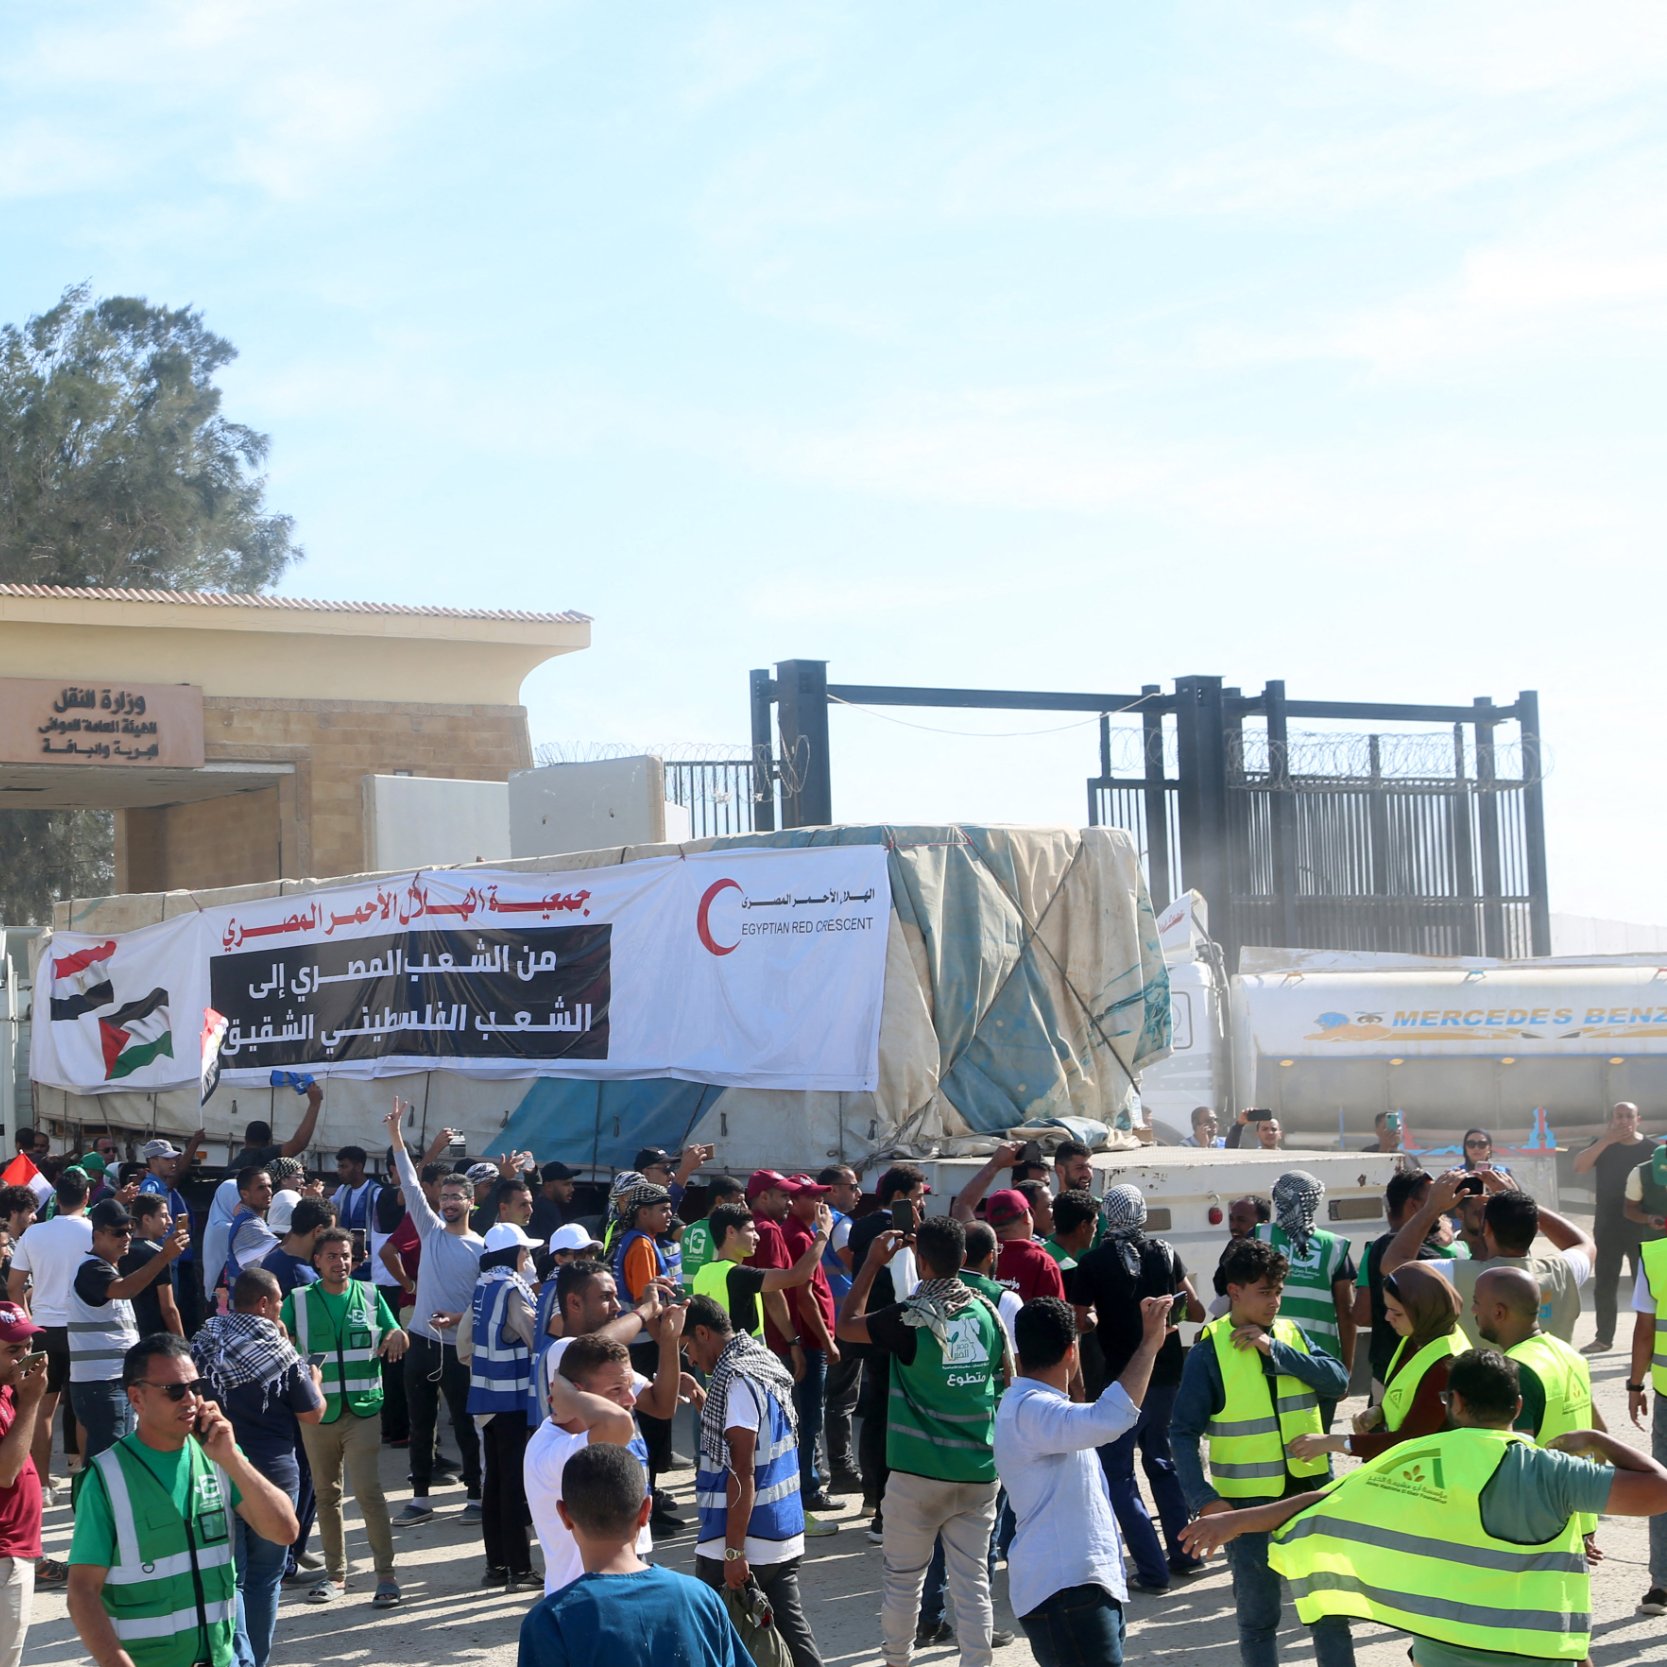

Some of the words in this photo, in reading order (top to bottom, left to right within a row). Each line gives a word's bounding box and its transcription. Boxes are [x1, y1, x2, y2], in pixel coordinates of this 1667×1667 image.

[53, 687, 96, 713] النقل
[101, 688, 146, 715] وزارة
[324, 885, 397, 936] الأحمر
[399, 885, 485, 925] الهلال
[487, 885, 592, 920] جمعية
[222, 901, 323, 953] المصري
[741, 922, 790, 936] EGYPTIAN
[791, 920, 813, 934] RED
[815, 917, 874, 933] CRESCENT
[291, 948, 402, 1002] المصري
[404, 938, 510, 982] الشعب
[516, 945, 557, 981] من
[249, 963, 285, 999] إلى
[219, 1009, 314, 1056] الشقيق
[320, 1001, 467, 1055] الفلسطيني
[475, 995, 592, 1041] الشعب
[1392, 1007, 1574, 1027] MERCEDES
[947, 1372, 986, 1386] متطوع
